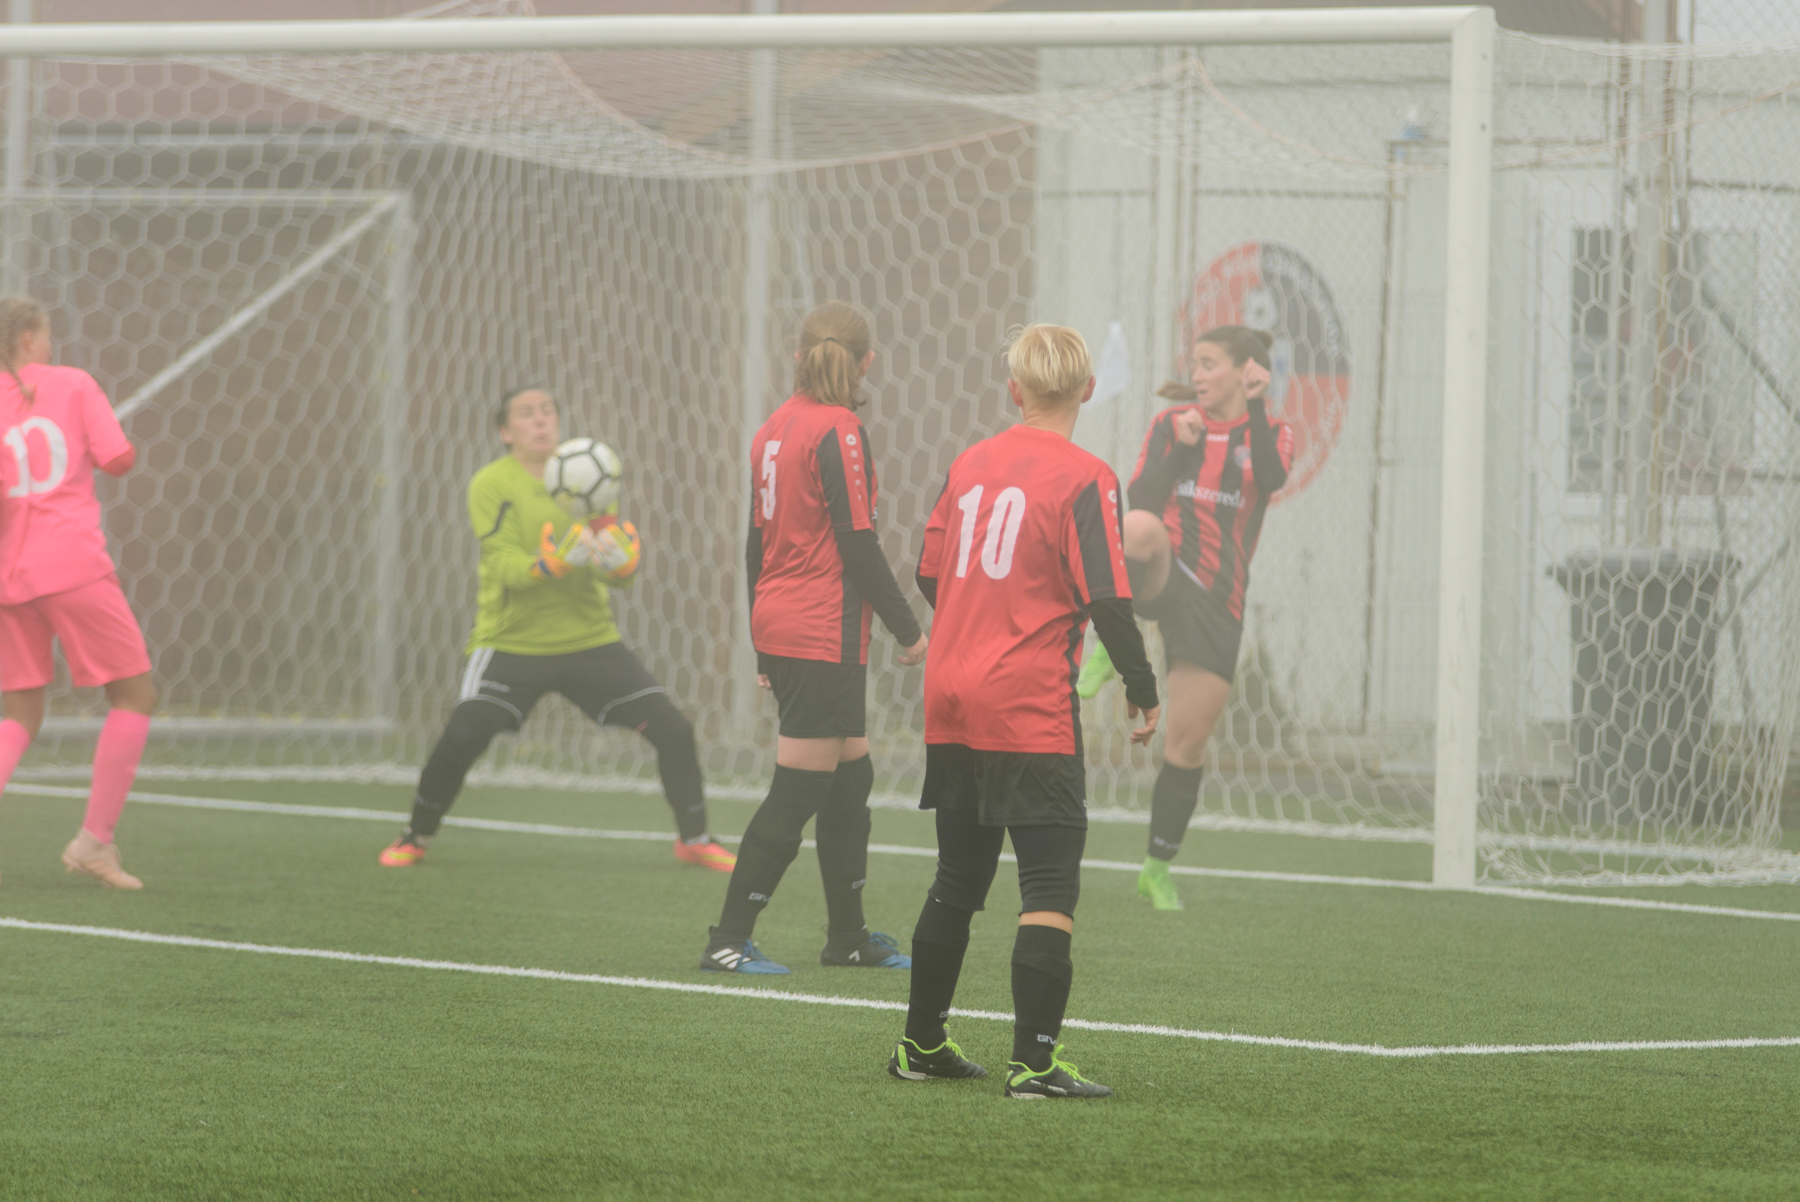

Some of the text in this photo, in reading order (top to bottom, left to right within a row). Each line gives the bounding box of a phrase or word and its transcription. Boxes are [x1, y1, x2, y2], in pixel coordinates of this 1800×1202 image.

[4, 416, 69, 498] 10
[760, 440, 782, 520] 5
[1172, 479, 1247, 509] sikszereda
[956, 484, 1026, 580] 10
